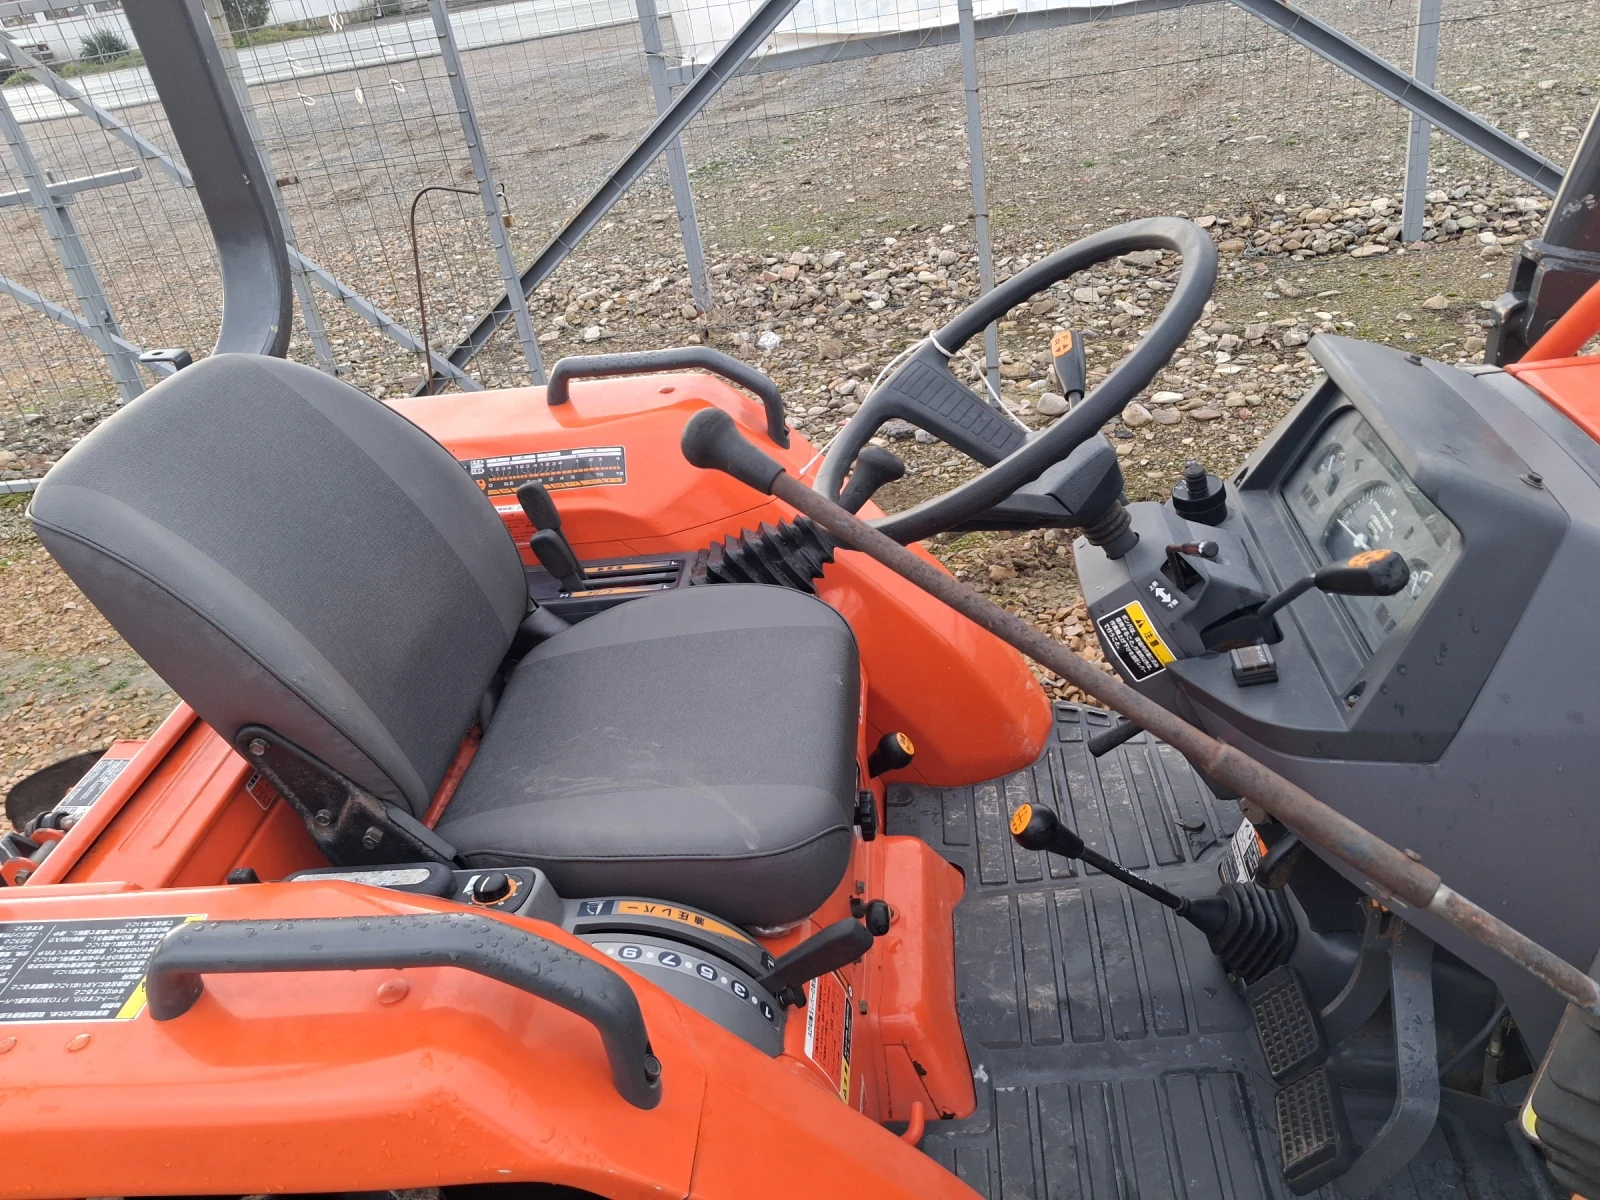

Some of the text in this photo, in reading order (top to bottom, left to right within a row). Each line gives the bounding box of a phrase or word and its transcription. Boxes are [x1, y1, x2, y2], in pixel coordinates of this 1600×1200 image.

[1144, 631, 1159, 647] 注意
[627, 905, 706, 926] 油圧レバー
[623, 947, 638, 958] 9
[662, 955, 677, 966] 7
[700, 966, 713, 978] 5
[734, 982, 746, 996] 3
